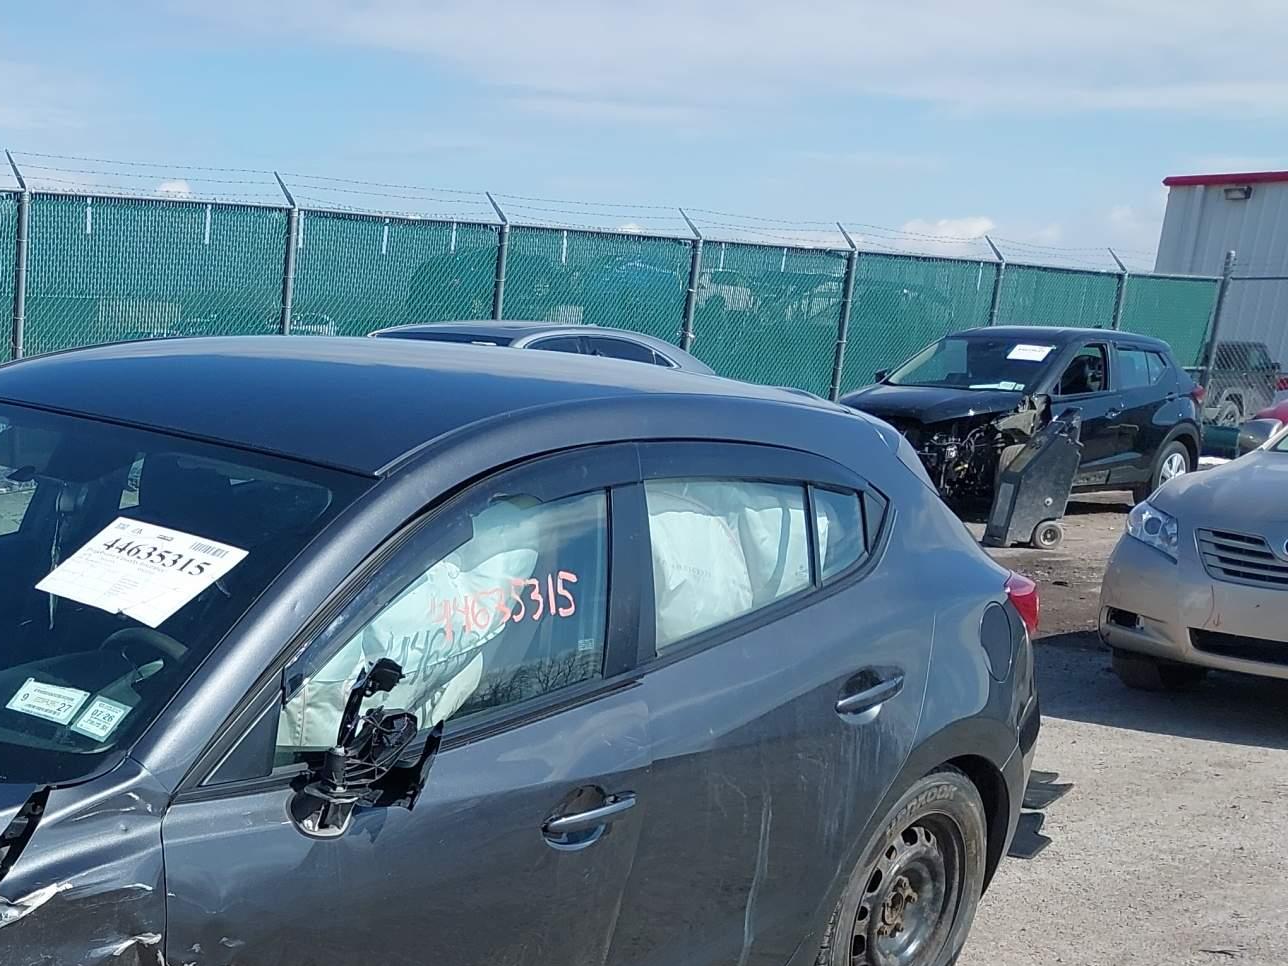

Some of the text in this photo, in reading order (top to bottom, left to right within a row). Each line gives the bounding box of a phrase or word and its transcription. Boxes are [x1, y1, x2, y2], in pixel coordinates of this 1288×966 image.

[103, 538, 211, 575] 44635315
[429, 571, 578, 641] 44635315
[56, 703, 73, 713] 27
